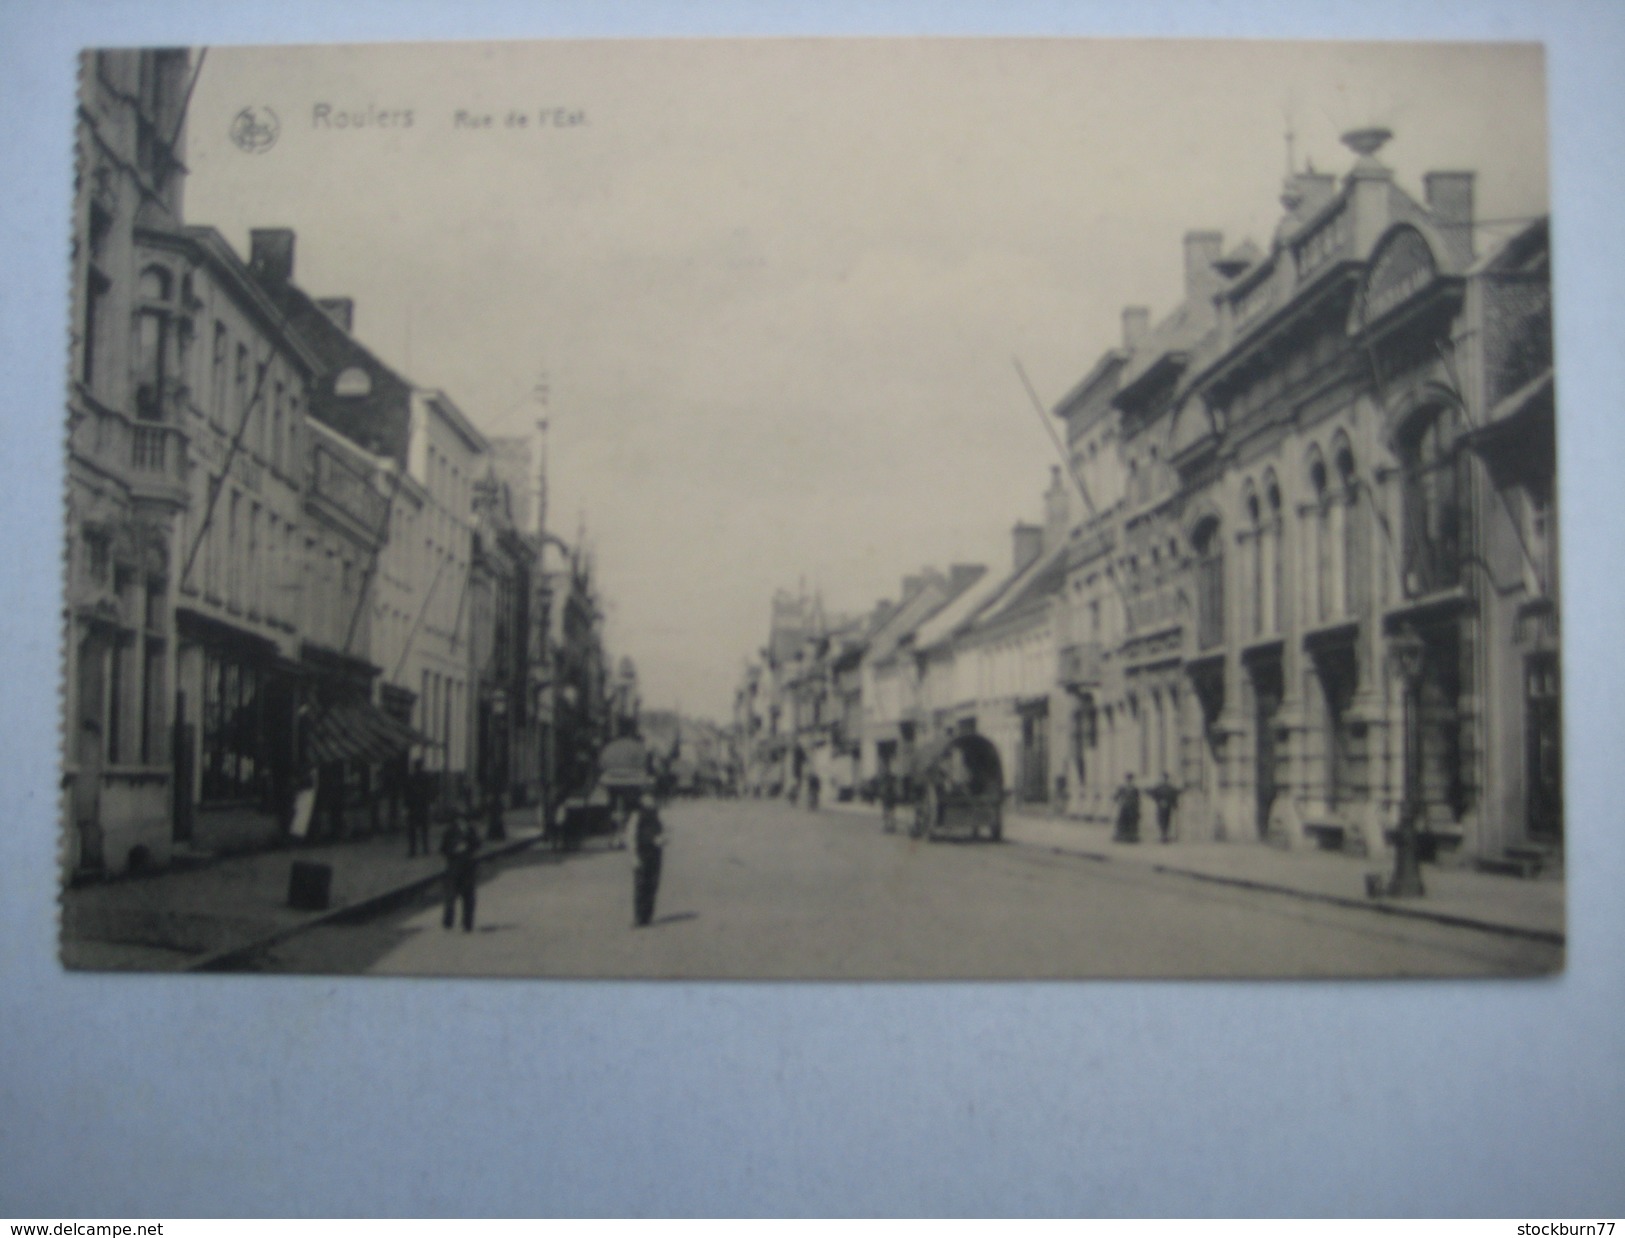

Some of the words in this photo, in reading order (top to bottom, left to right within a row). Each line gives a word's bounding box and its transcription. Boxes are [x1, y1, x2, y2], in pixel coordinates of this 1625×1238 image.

[311, 101, 415, 130] Roulers
[454, 108, 494, 130] Rue
[504, 106, 528, 130] de
